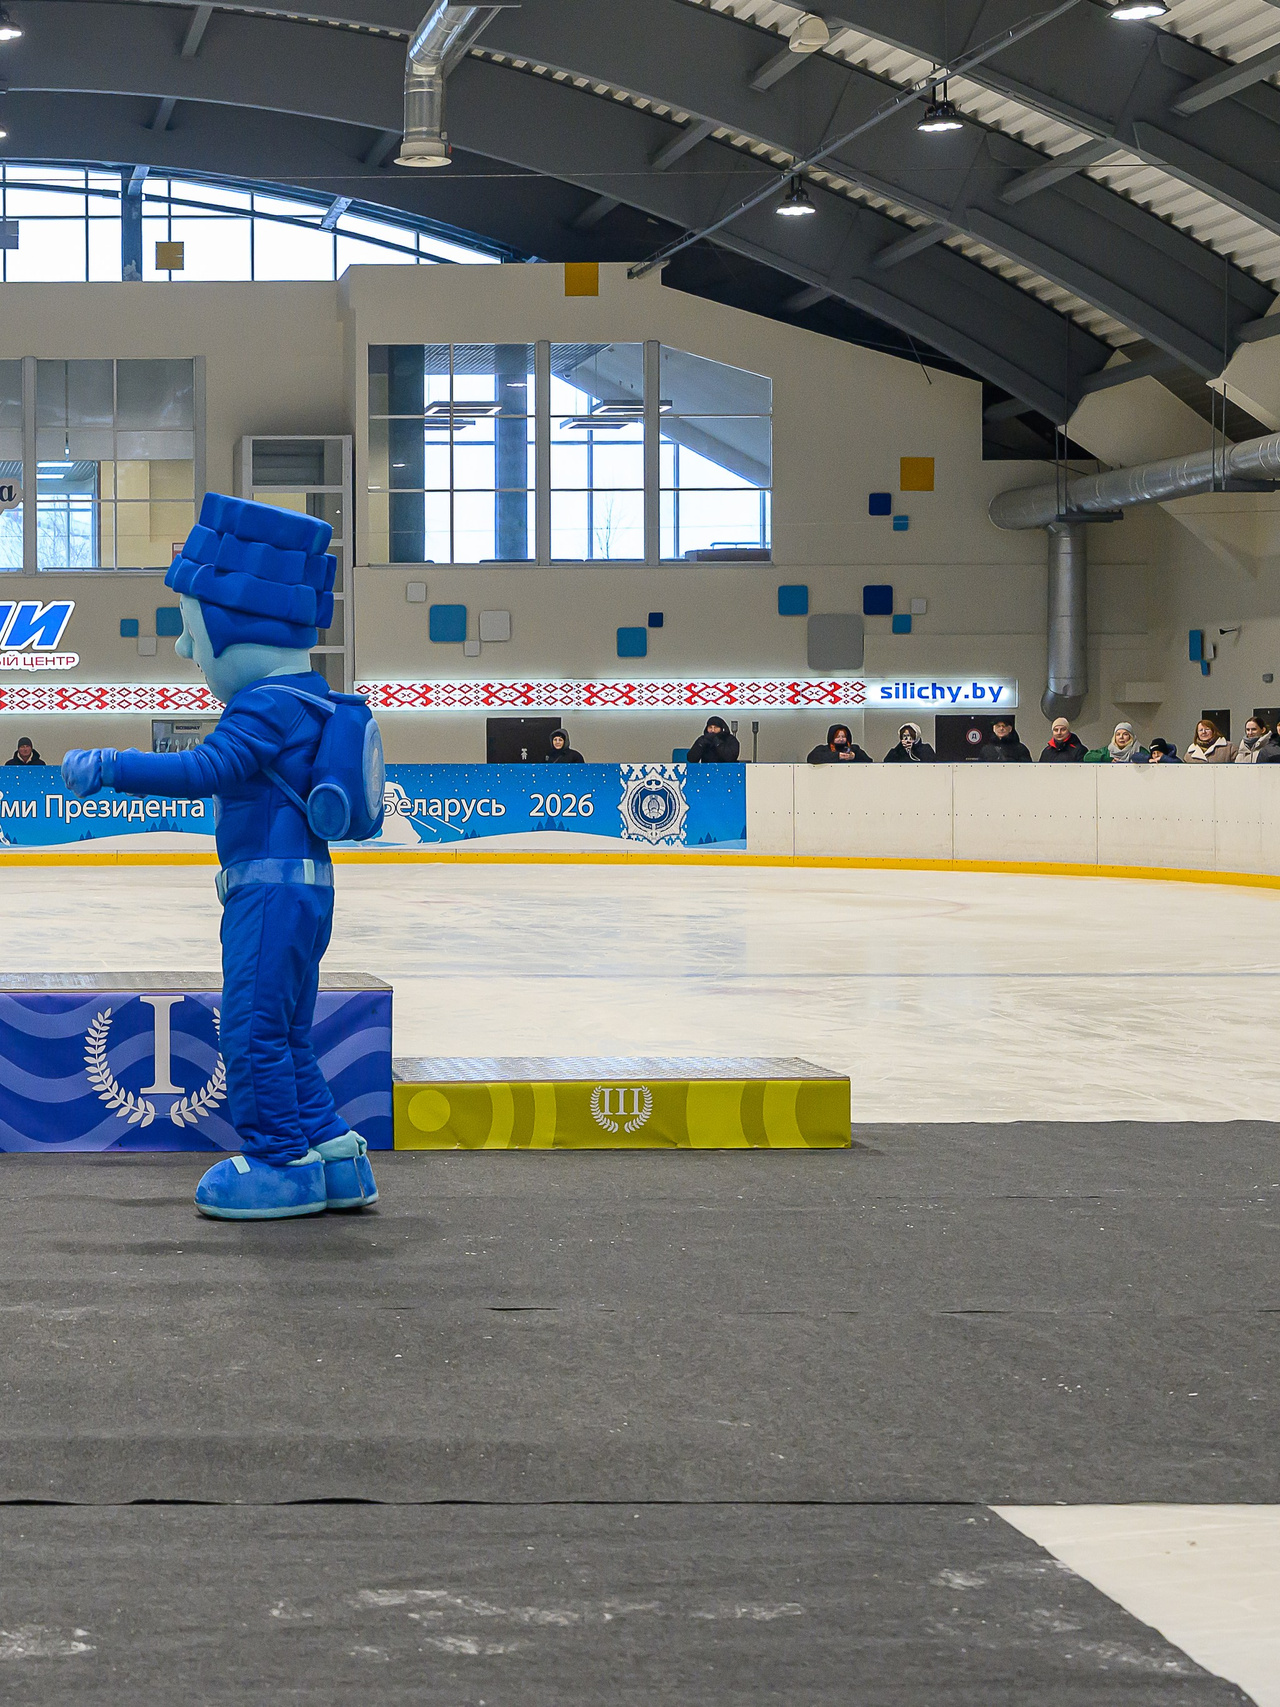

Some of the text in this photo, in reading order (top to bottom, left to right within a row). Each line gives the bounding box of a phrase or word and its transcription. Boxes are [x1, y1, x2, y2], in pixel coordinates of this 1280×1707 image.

[23, 656, 76, 669] ЦЕНТР
[880, 682, 1004, 703] silichy.by
[45, 794, 205, 823] Президента
[384, 792, 506, 818] Беларусь
[529, 793, 595, 818] 2026
[601, 1087, 642, 1116] III
